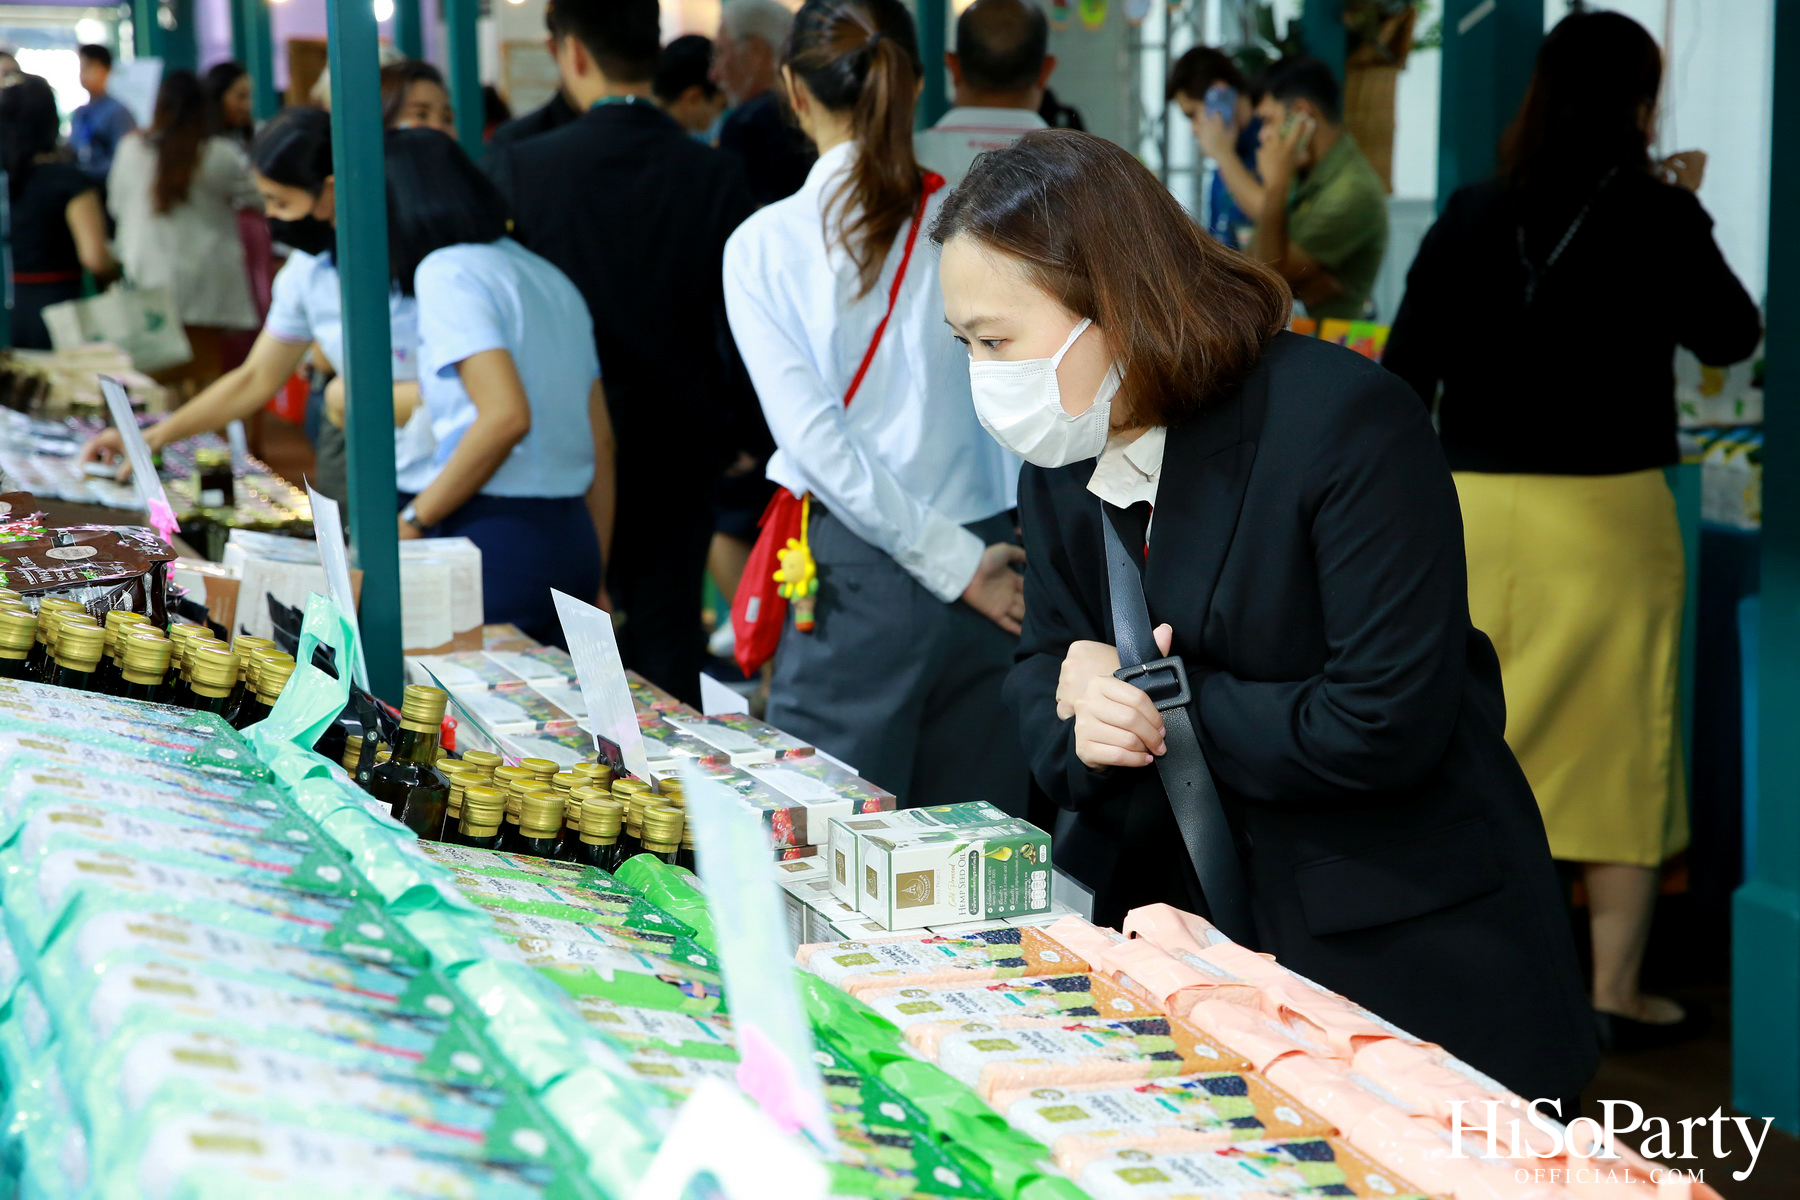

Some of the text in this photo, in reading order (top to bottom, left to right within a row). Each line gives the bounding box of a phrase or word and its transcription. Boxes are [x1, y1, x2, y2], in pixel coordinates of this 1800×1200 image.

[958, 852, 967, 915] HEMP SEED OIL
